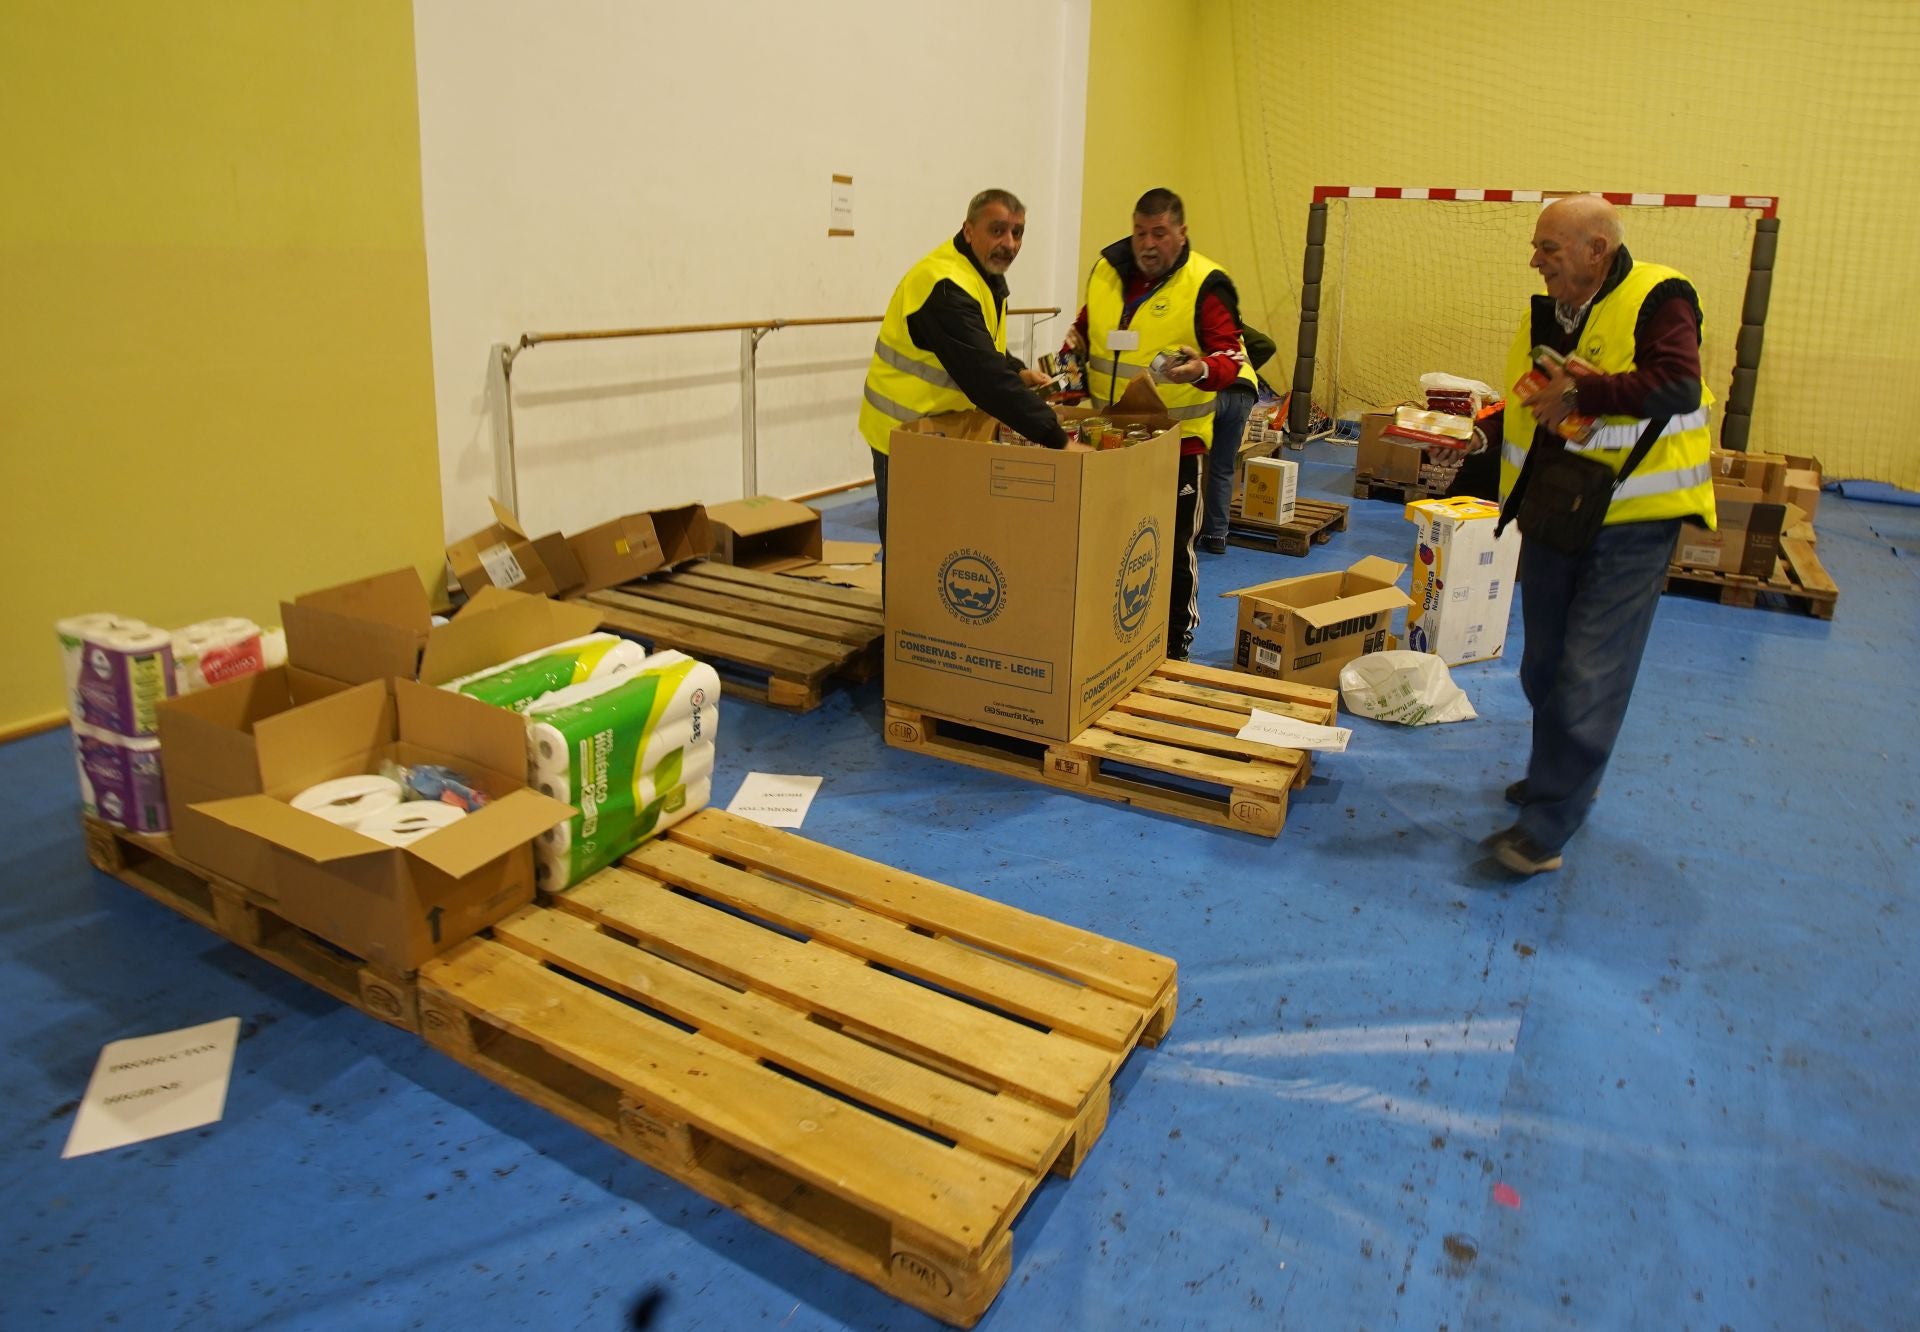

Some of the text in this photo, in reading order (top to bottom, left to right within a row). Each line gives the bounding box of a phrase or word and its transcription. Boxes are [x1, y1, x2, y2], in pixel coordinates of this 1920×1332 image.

[937, 548, 1007, 588] BANCOS DE ALIMENTOS
[952, 569, 991, 584] FESBAL
[1127, 549, 1154, 576] FESBAL
[937, 586, 1007, 626] BANCOS DE ALIMENTOS
[900, 640, 957, 660] CONSERVAS
[965, 654, 1002, 670] ACEITE
[1010, 664, 1046, 679] LECHE
[1251, 635, 1282, 654] chelino
[1083, 668, 1121, 703] CONSERVAS
[1124, 648, 1144, 672] ACEITE
[1146, 633, 1161, 654] LECHE
[995, 708, 1044, 726] Smurfit Kappa
